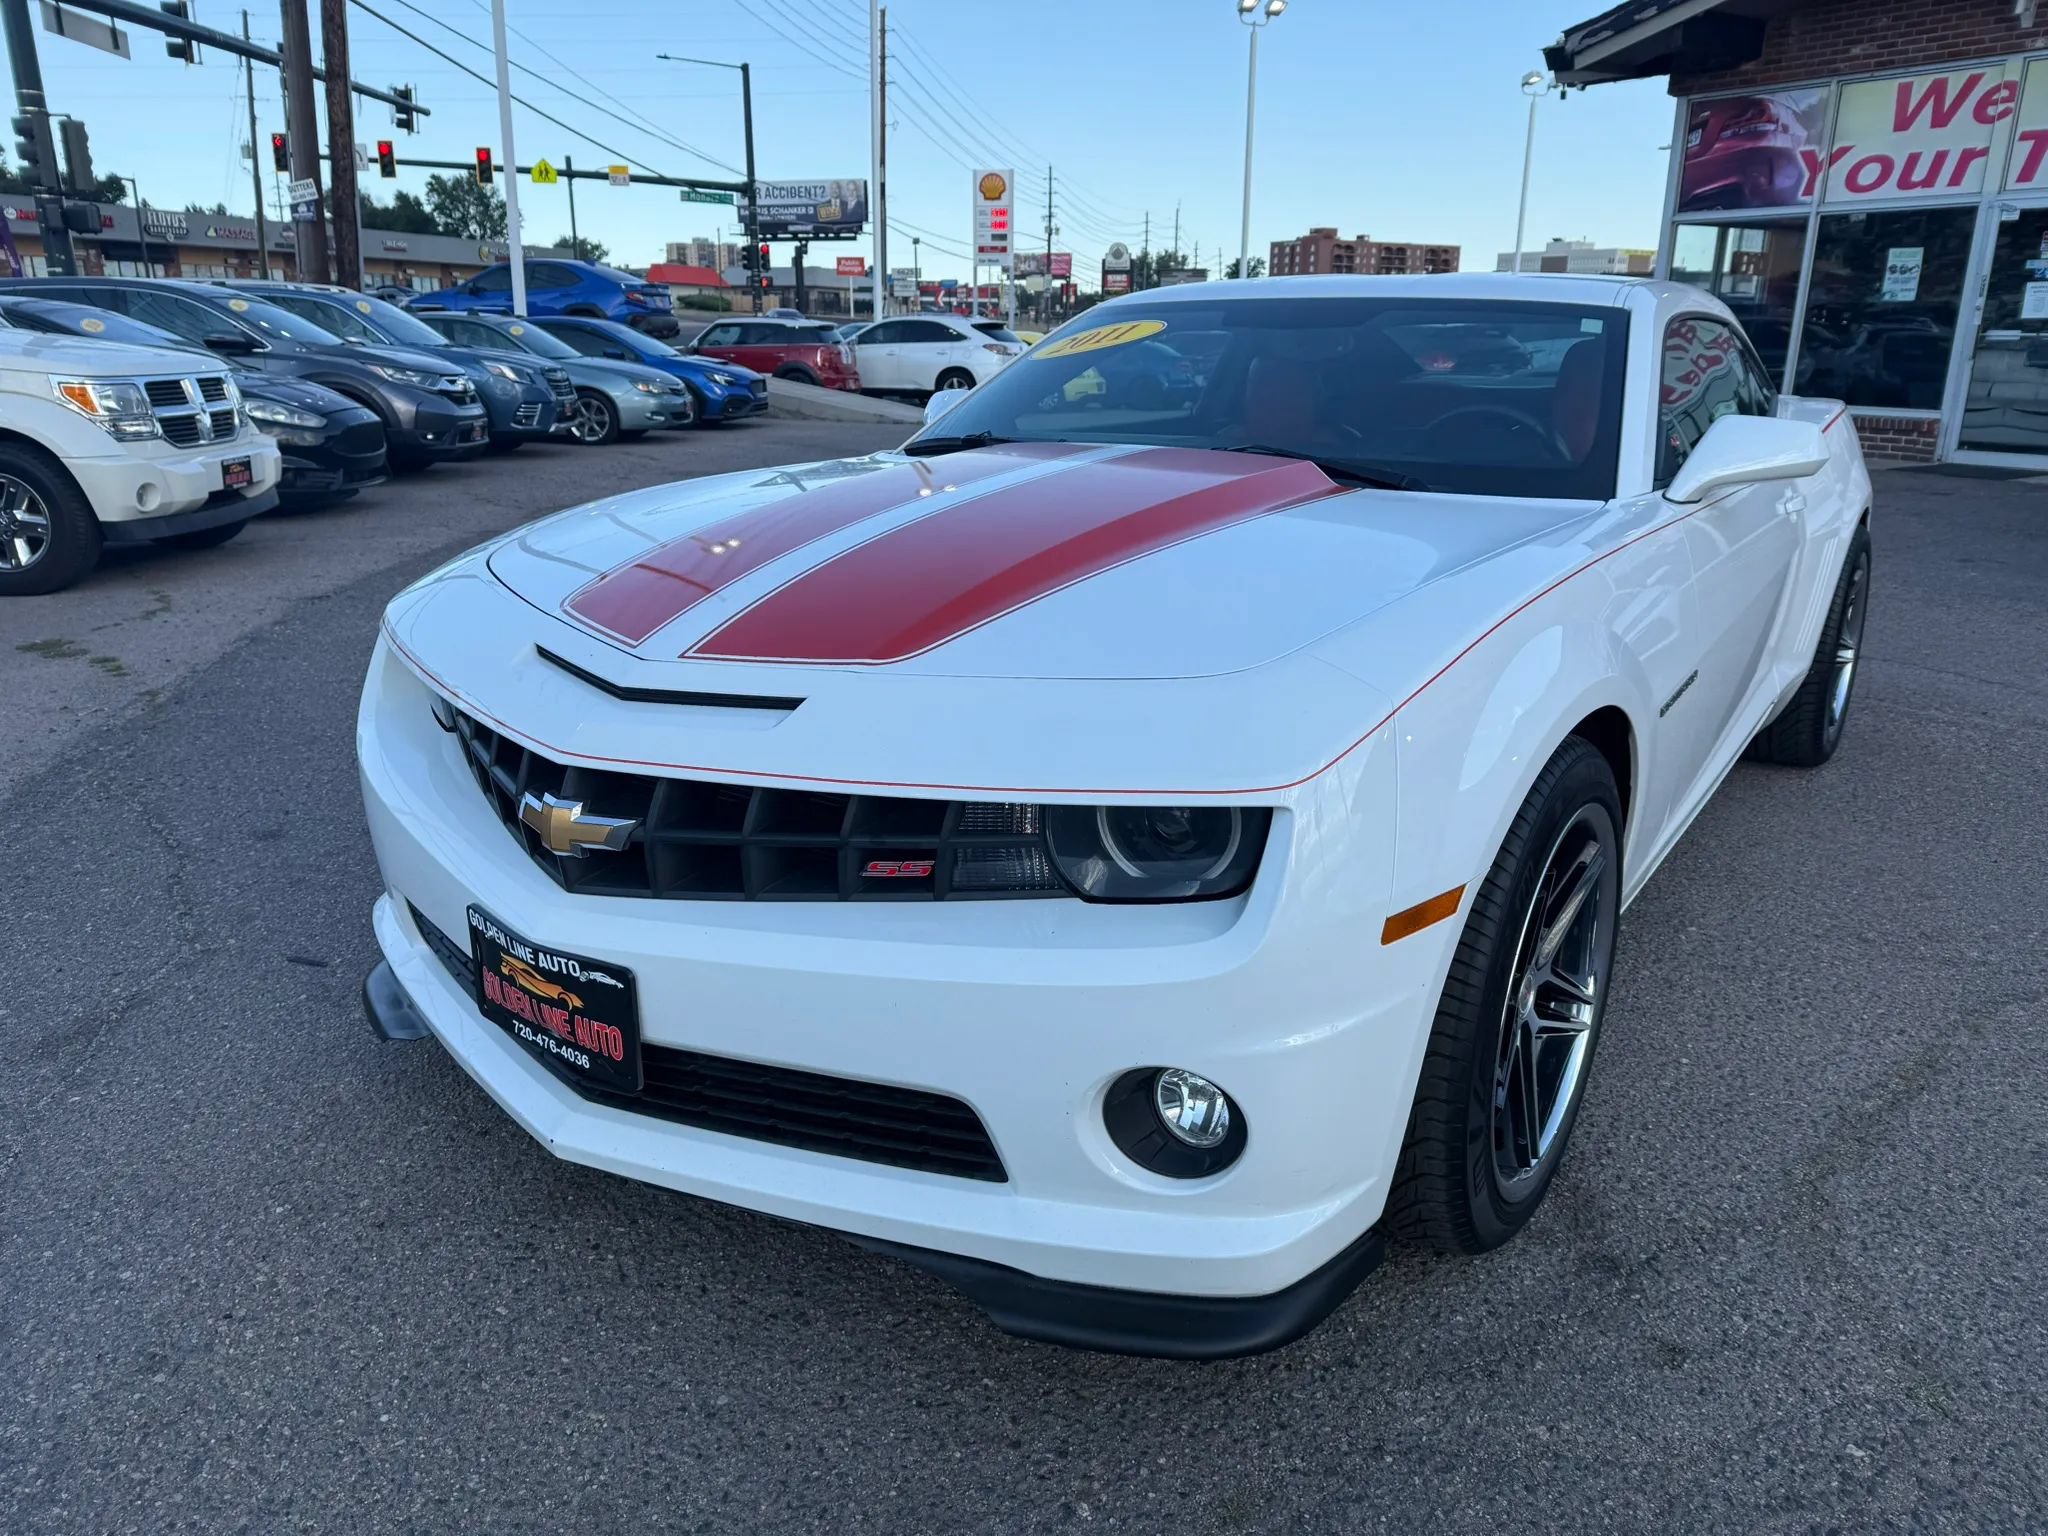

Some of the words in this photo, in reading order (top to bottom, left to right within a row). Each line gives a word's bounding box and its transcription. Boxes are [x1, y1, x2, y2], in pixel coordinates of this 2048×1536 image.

[1893, 72, 2019, 133] We
[764, 184, 826, 200] ACCIDENT?
[1799, 144, 1990, 197] Your
[147, 210, 187, 227] FLOYD'S
[1045, 324, 1142, 355] 2011
[861, 860, 936, 876] SS
[468, 908, 507, 949] GOLDEN
[507, 936, 536, 965] LINE
[538, 952, 581, 977] AUTO
[482, 965, 534, 1023] GOLDEN
[531, 998, 576, 1043] LINE
[574, 1014, 624, 1061] AUTO
[512, 1019, 590, 1069] 720-476-4036
